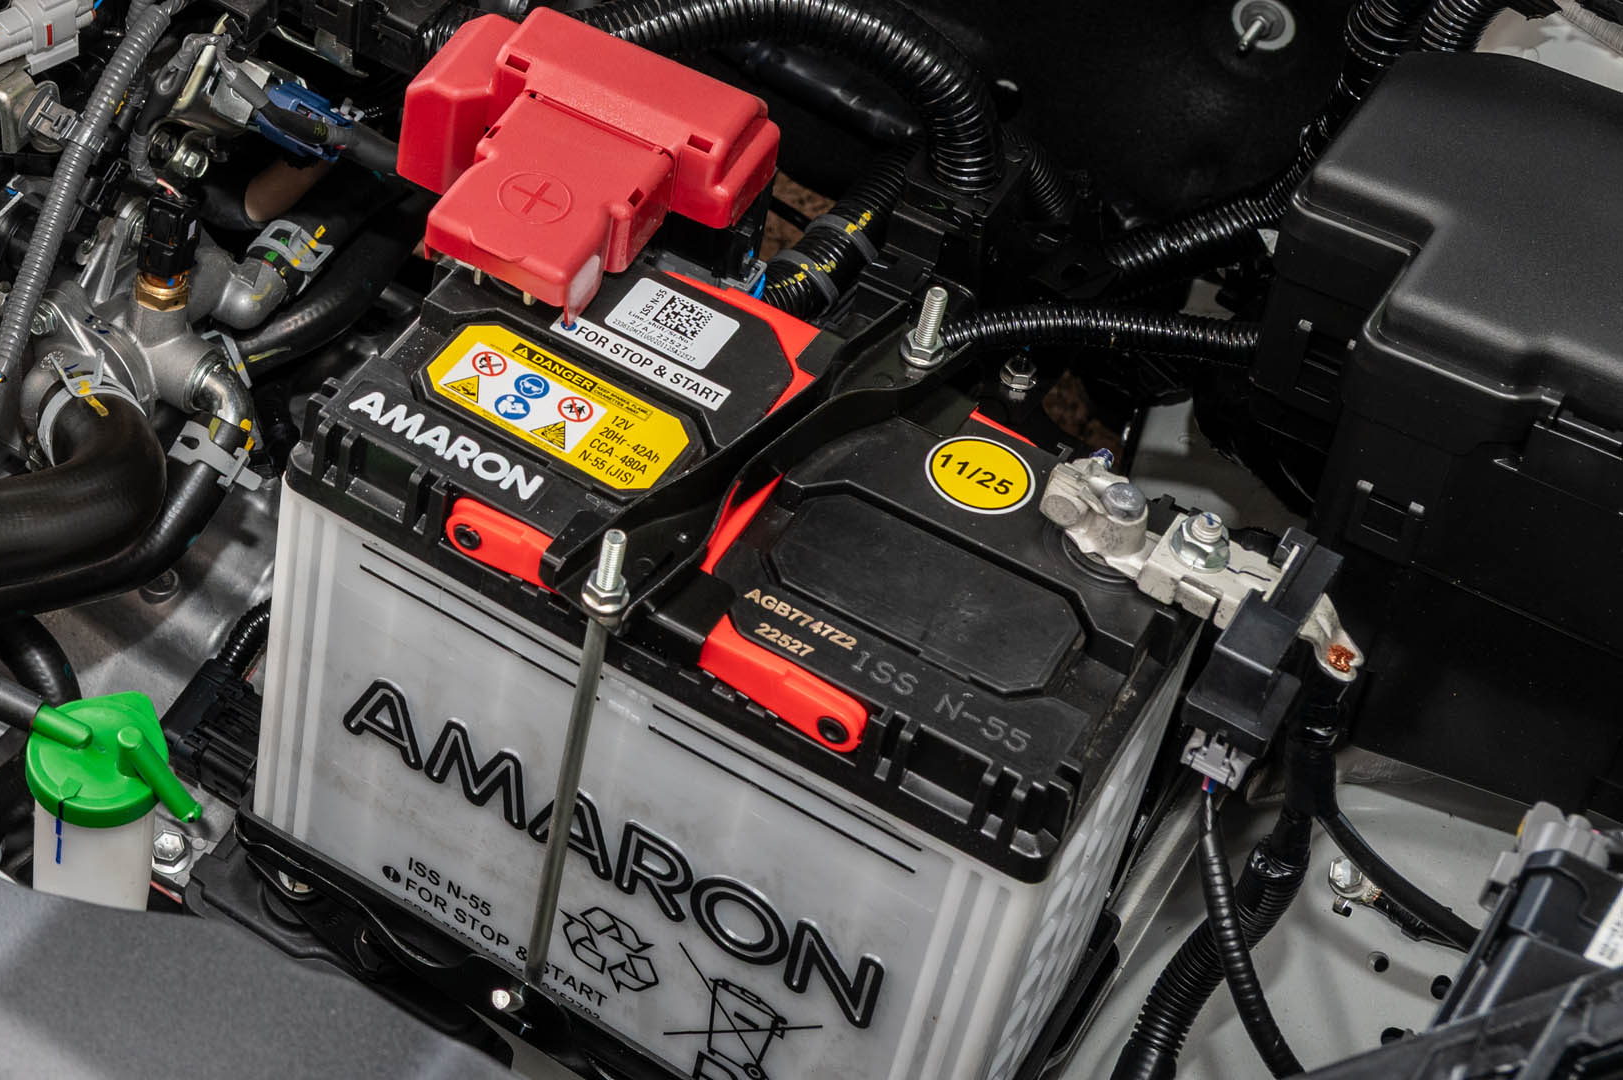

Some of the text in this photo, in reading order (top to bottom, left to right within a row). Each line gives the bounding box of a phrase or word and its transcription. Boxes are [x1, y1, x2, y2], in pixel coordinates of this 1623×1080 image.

[531, 354, 596, 391] DANGER
[575, 327, 723, 404] FOR STOP & START
[349, 391, 544, 500] AMARON
[599, 427, 626, 446] 20Hr
[631, 444, 660, 464] 42Ah
[611, 415, 635, 431] 12V
[578, 450, 635, 486] N-55 (JIS)
[589, 439, 614, 458] CCA
[620, 456, 648, 475] 480A
[939, 452, 1014, 497] 11/25
[754, 622, 815, 658] 22527
[851, 651, 1033, 754] ISS N-55
[342, 677, 885, 1028] AMARON
[408, 857, 492, 917] ISS N-55
[404, 878, 448, 914] FOR
[453, 906, 511, 948] STOP
